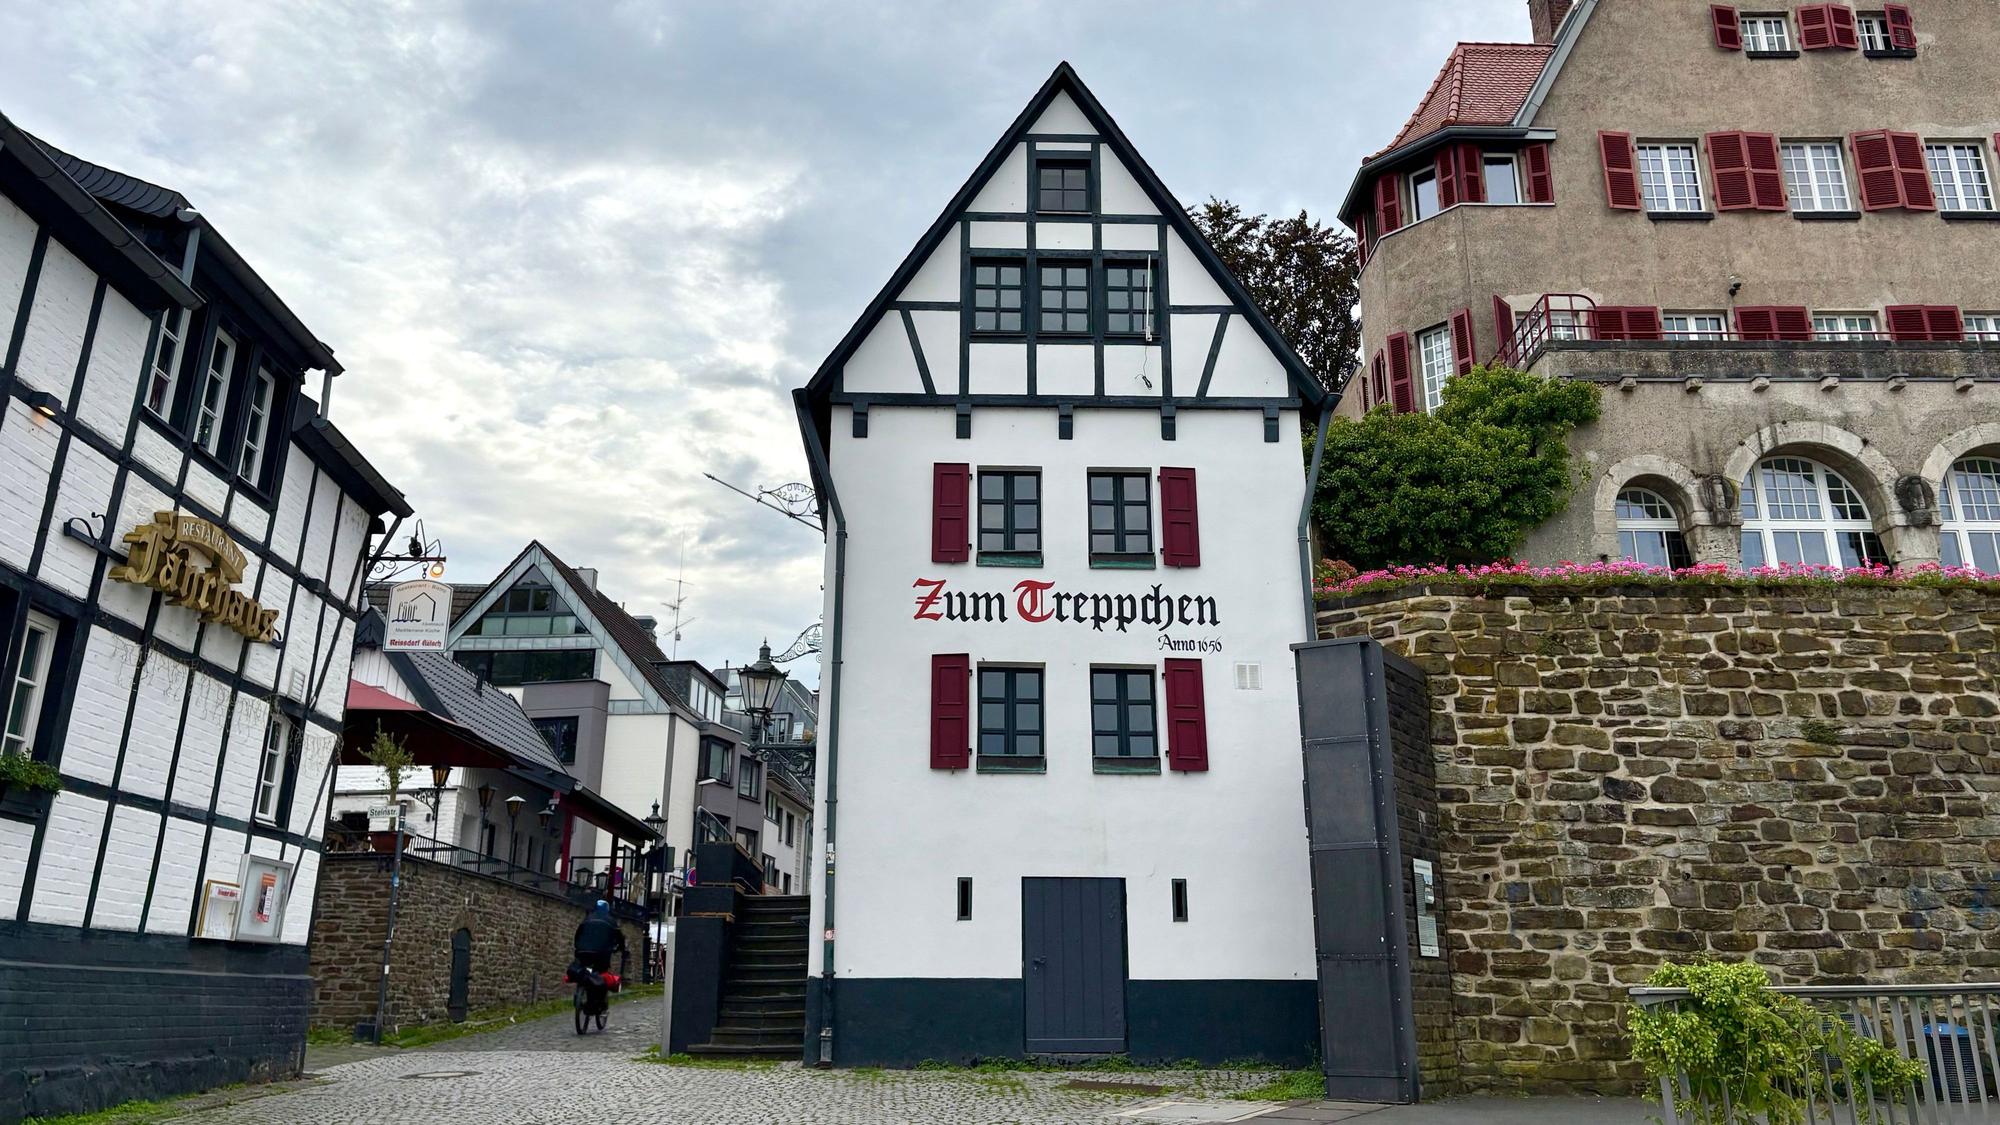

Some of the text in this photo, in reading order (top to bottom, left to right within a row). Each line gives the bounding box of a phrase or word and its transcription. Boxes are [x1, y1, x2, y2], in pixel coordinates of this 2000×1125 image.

[182, 521, 241, 568] RESTAURANT
[912, 578, 1221, 633] Zum Treppchen
[1157, 634, 1223, 655] Anno 1656
[370, 808, 398, 816] Steinstr.
